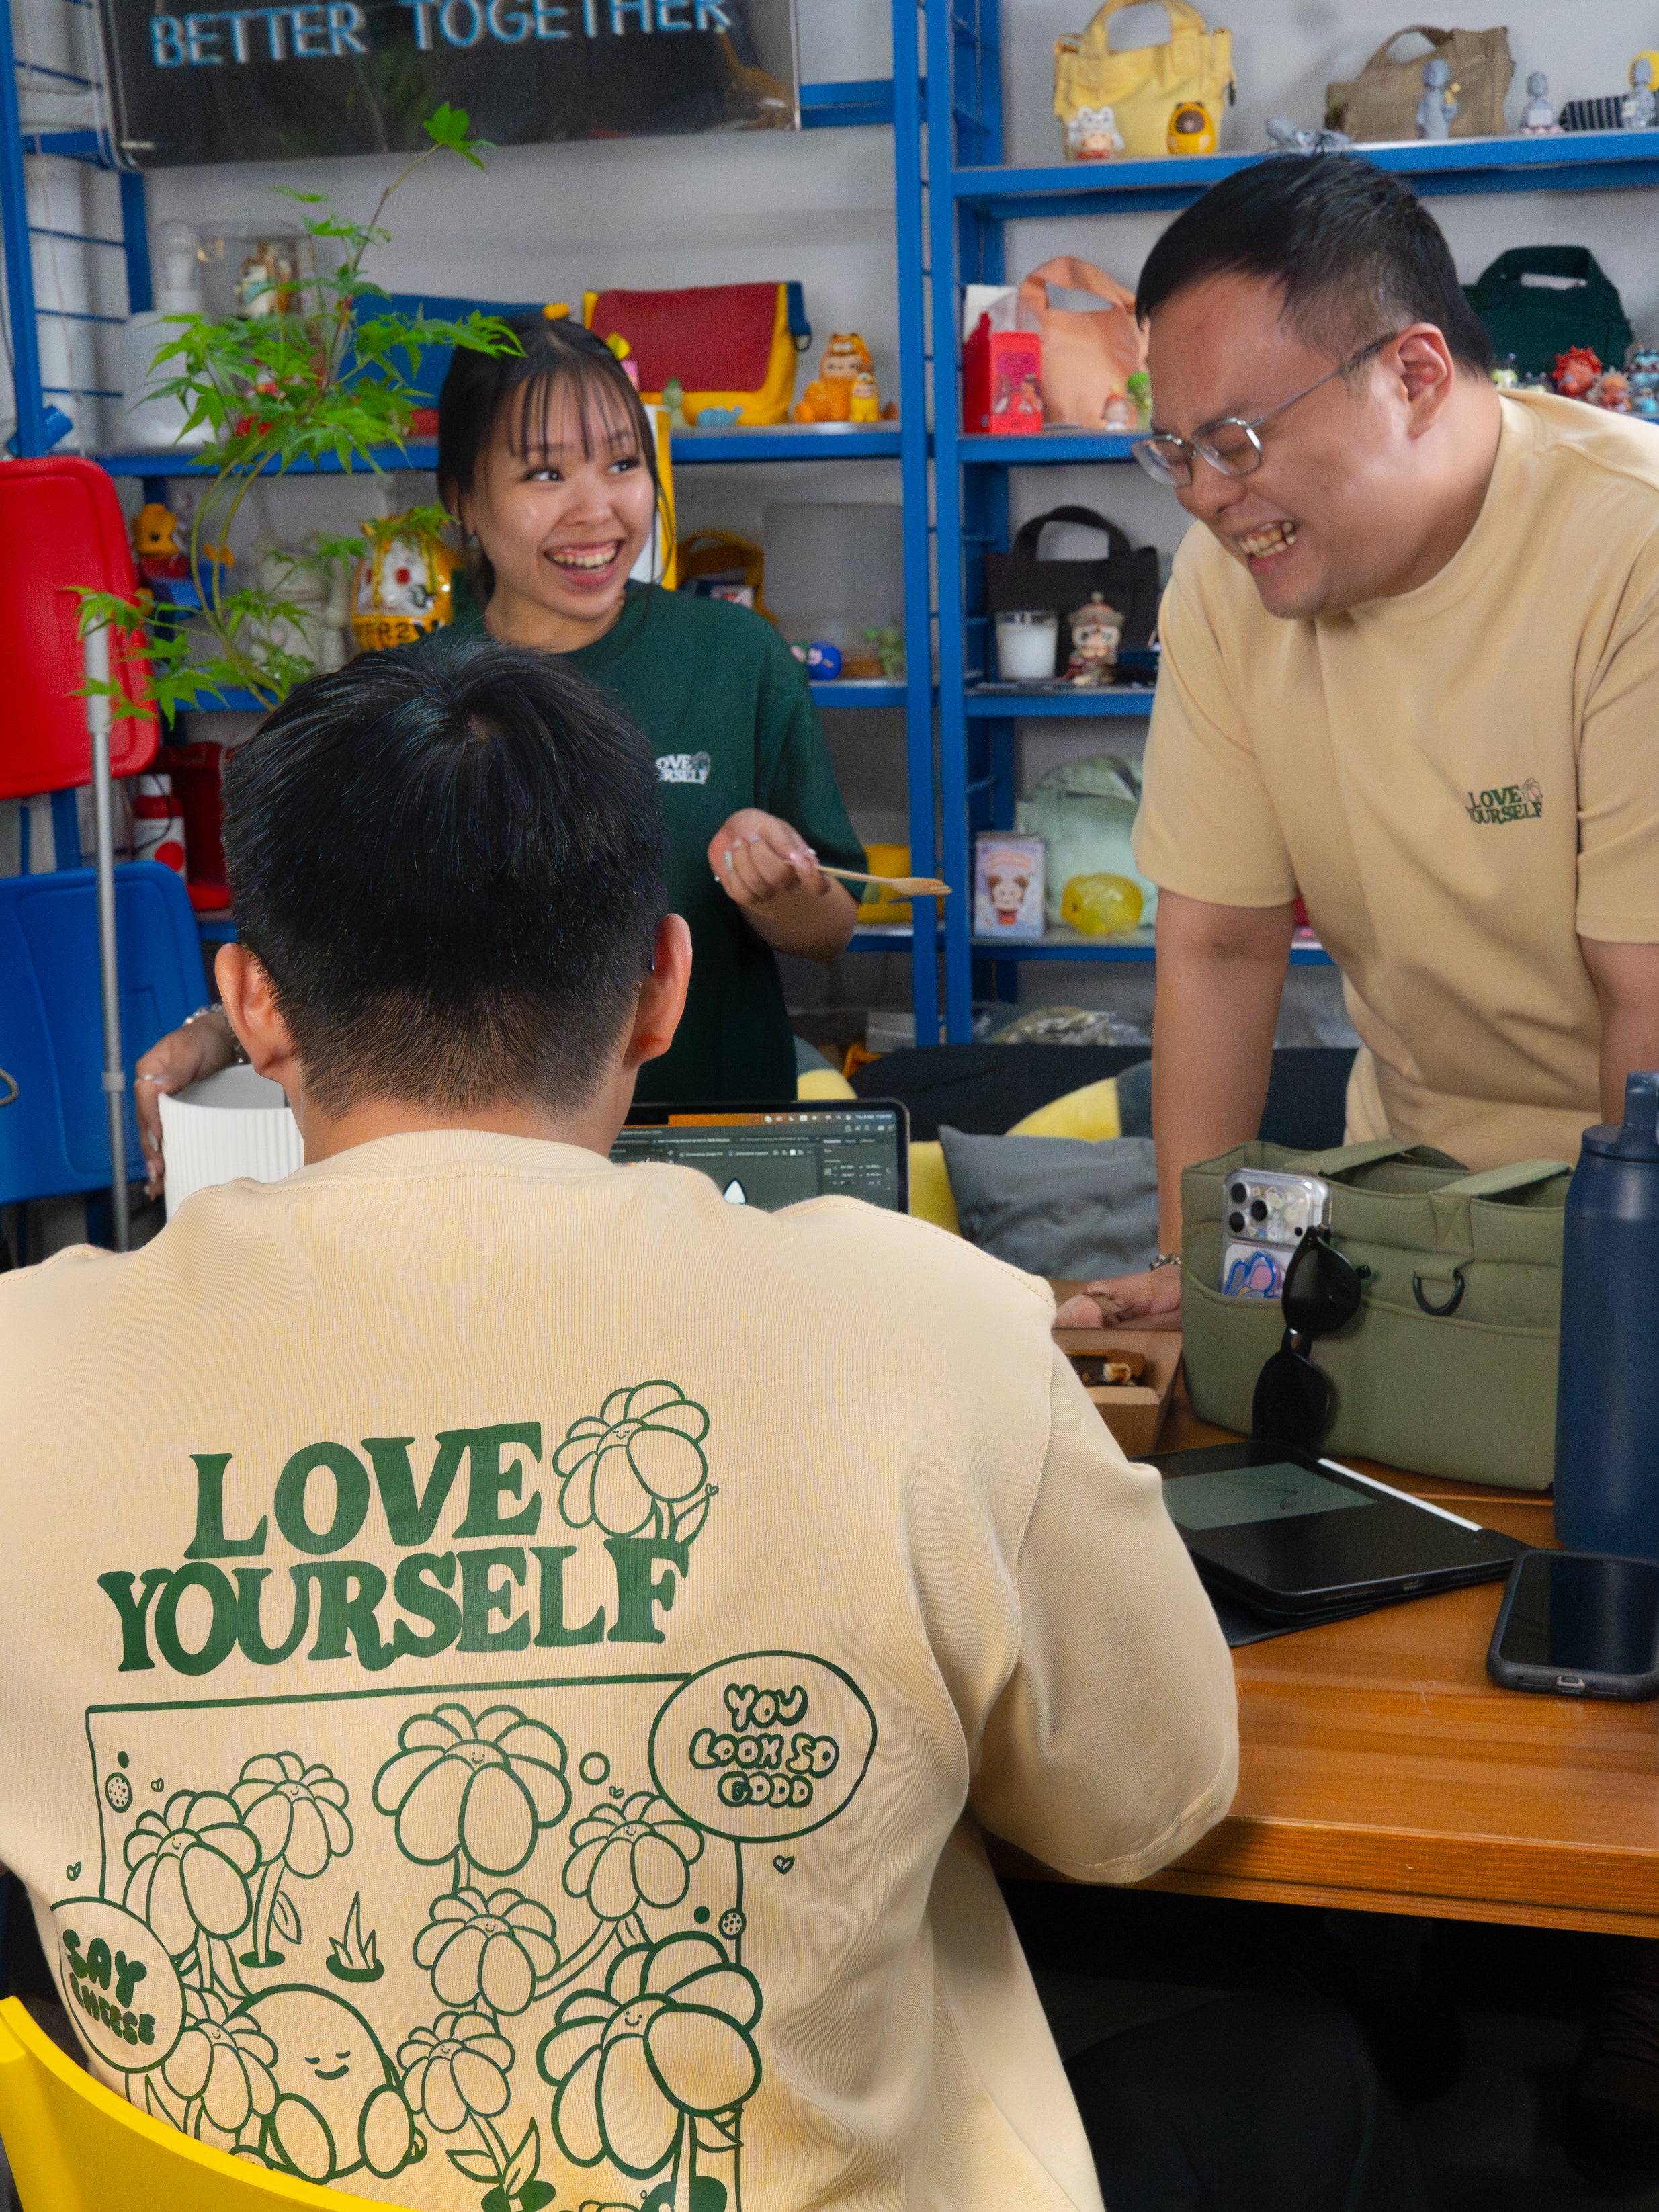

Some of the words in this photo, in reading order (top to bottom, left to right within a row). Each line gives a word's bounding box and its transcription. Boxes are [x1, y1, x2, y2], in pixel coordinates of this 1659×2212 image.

[150, 1, 368, 66] BETTER
[398, 0, 733, 51] TOGETHER
[655, 753, 693, 771] OVE
[1465, 802, 1542, 824] YOURSELF
[1467, 785, 1522, 808] LOVE
[183, 1422, 542, 1559] LOVE
[97, 1537, 689, 1676] YOURSELF
[723, 1683, 808, 1732] YOU
[689, 1728, 784, 1769] LOOK
[785, 1732, 840, 1779] SO
[717, 1771, 814, 1809] GOOD
[62, 1928, 147, 2008] SAY
[69, 1971, 156, 2045] CHEESE
